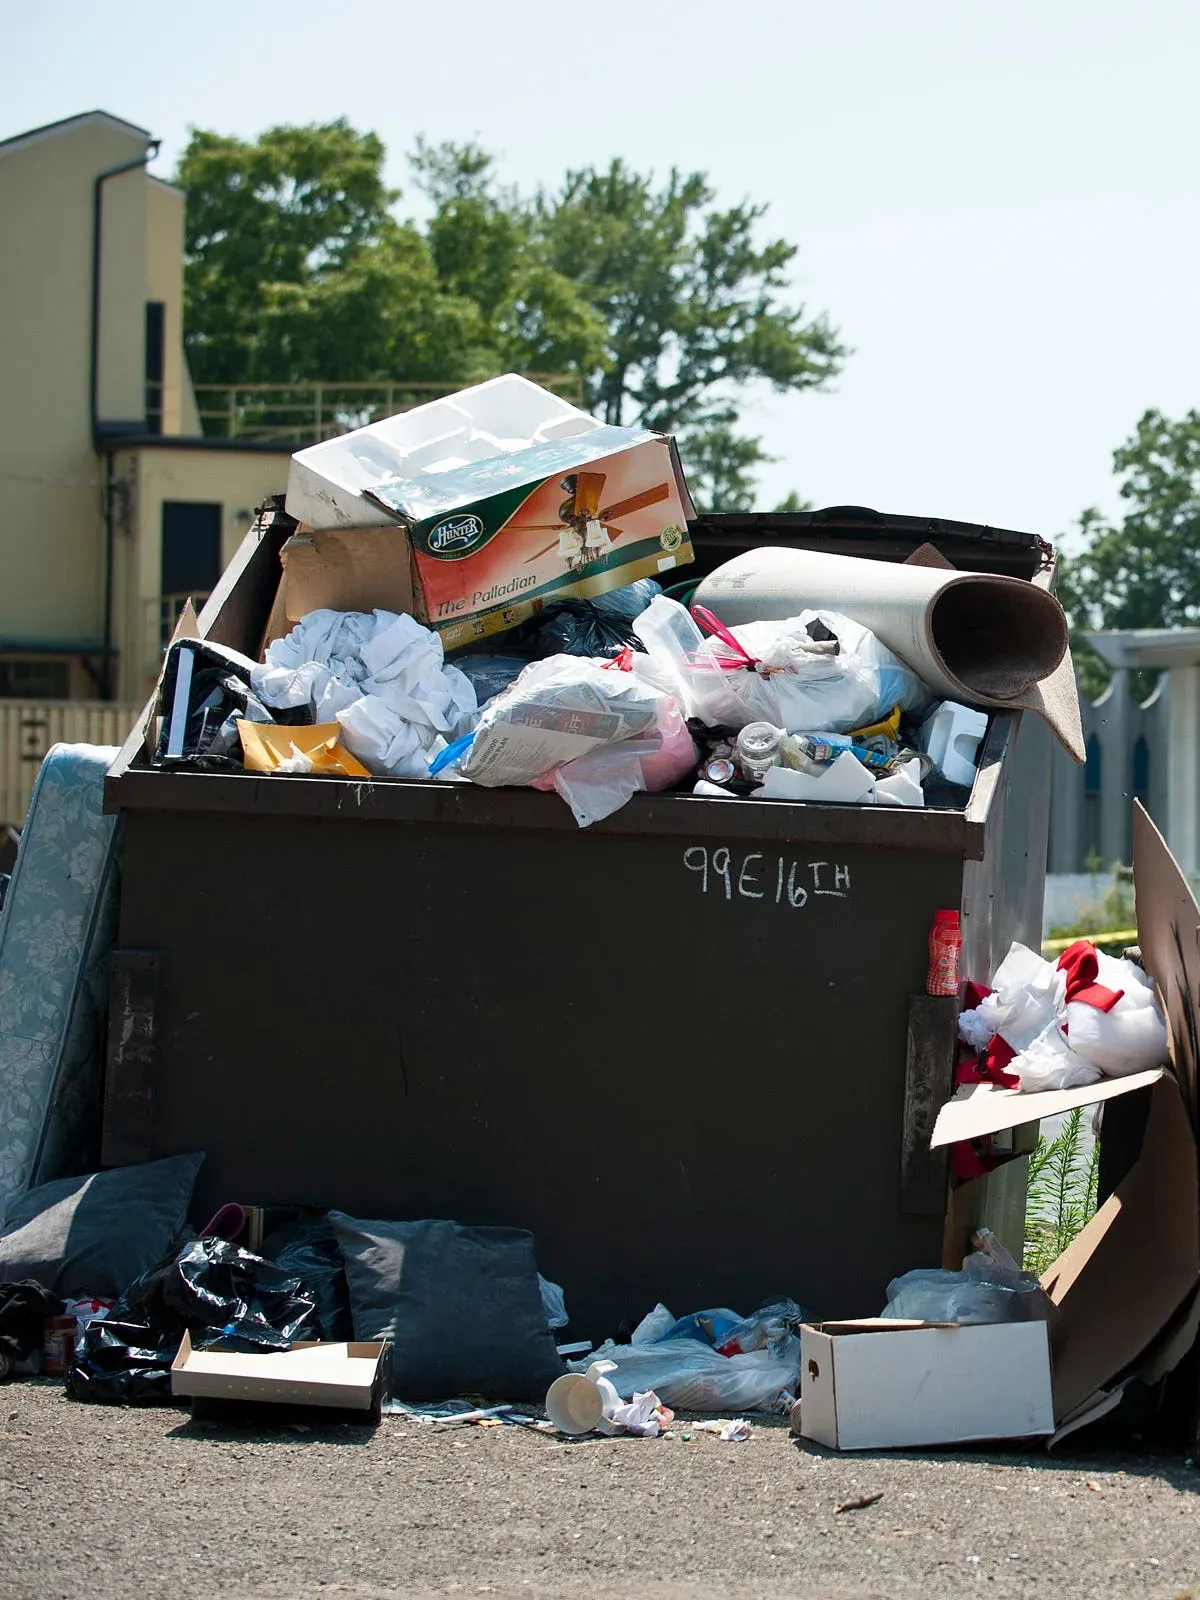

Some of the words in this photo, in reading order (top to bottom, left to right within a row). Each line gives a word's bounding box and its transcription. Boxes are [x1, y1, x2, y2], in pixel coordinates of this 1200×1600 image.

[433, 517, 479, 549] HUNTER
[437, 600, 466, 617] The
[472, 574, 537, 606] Palladian
